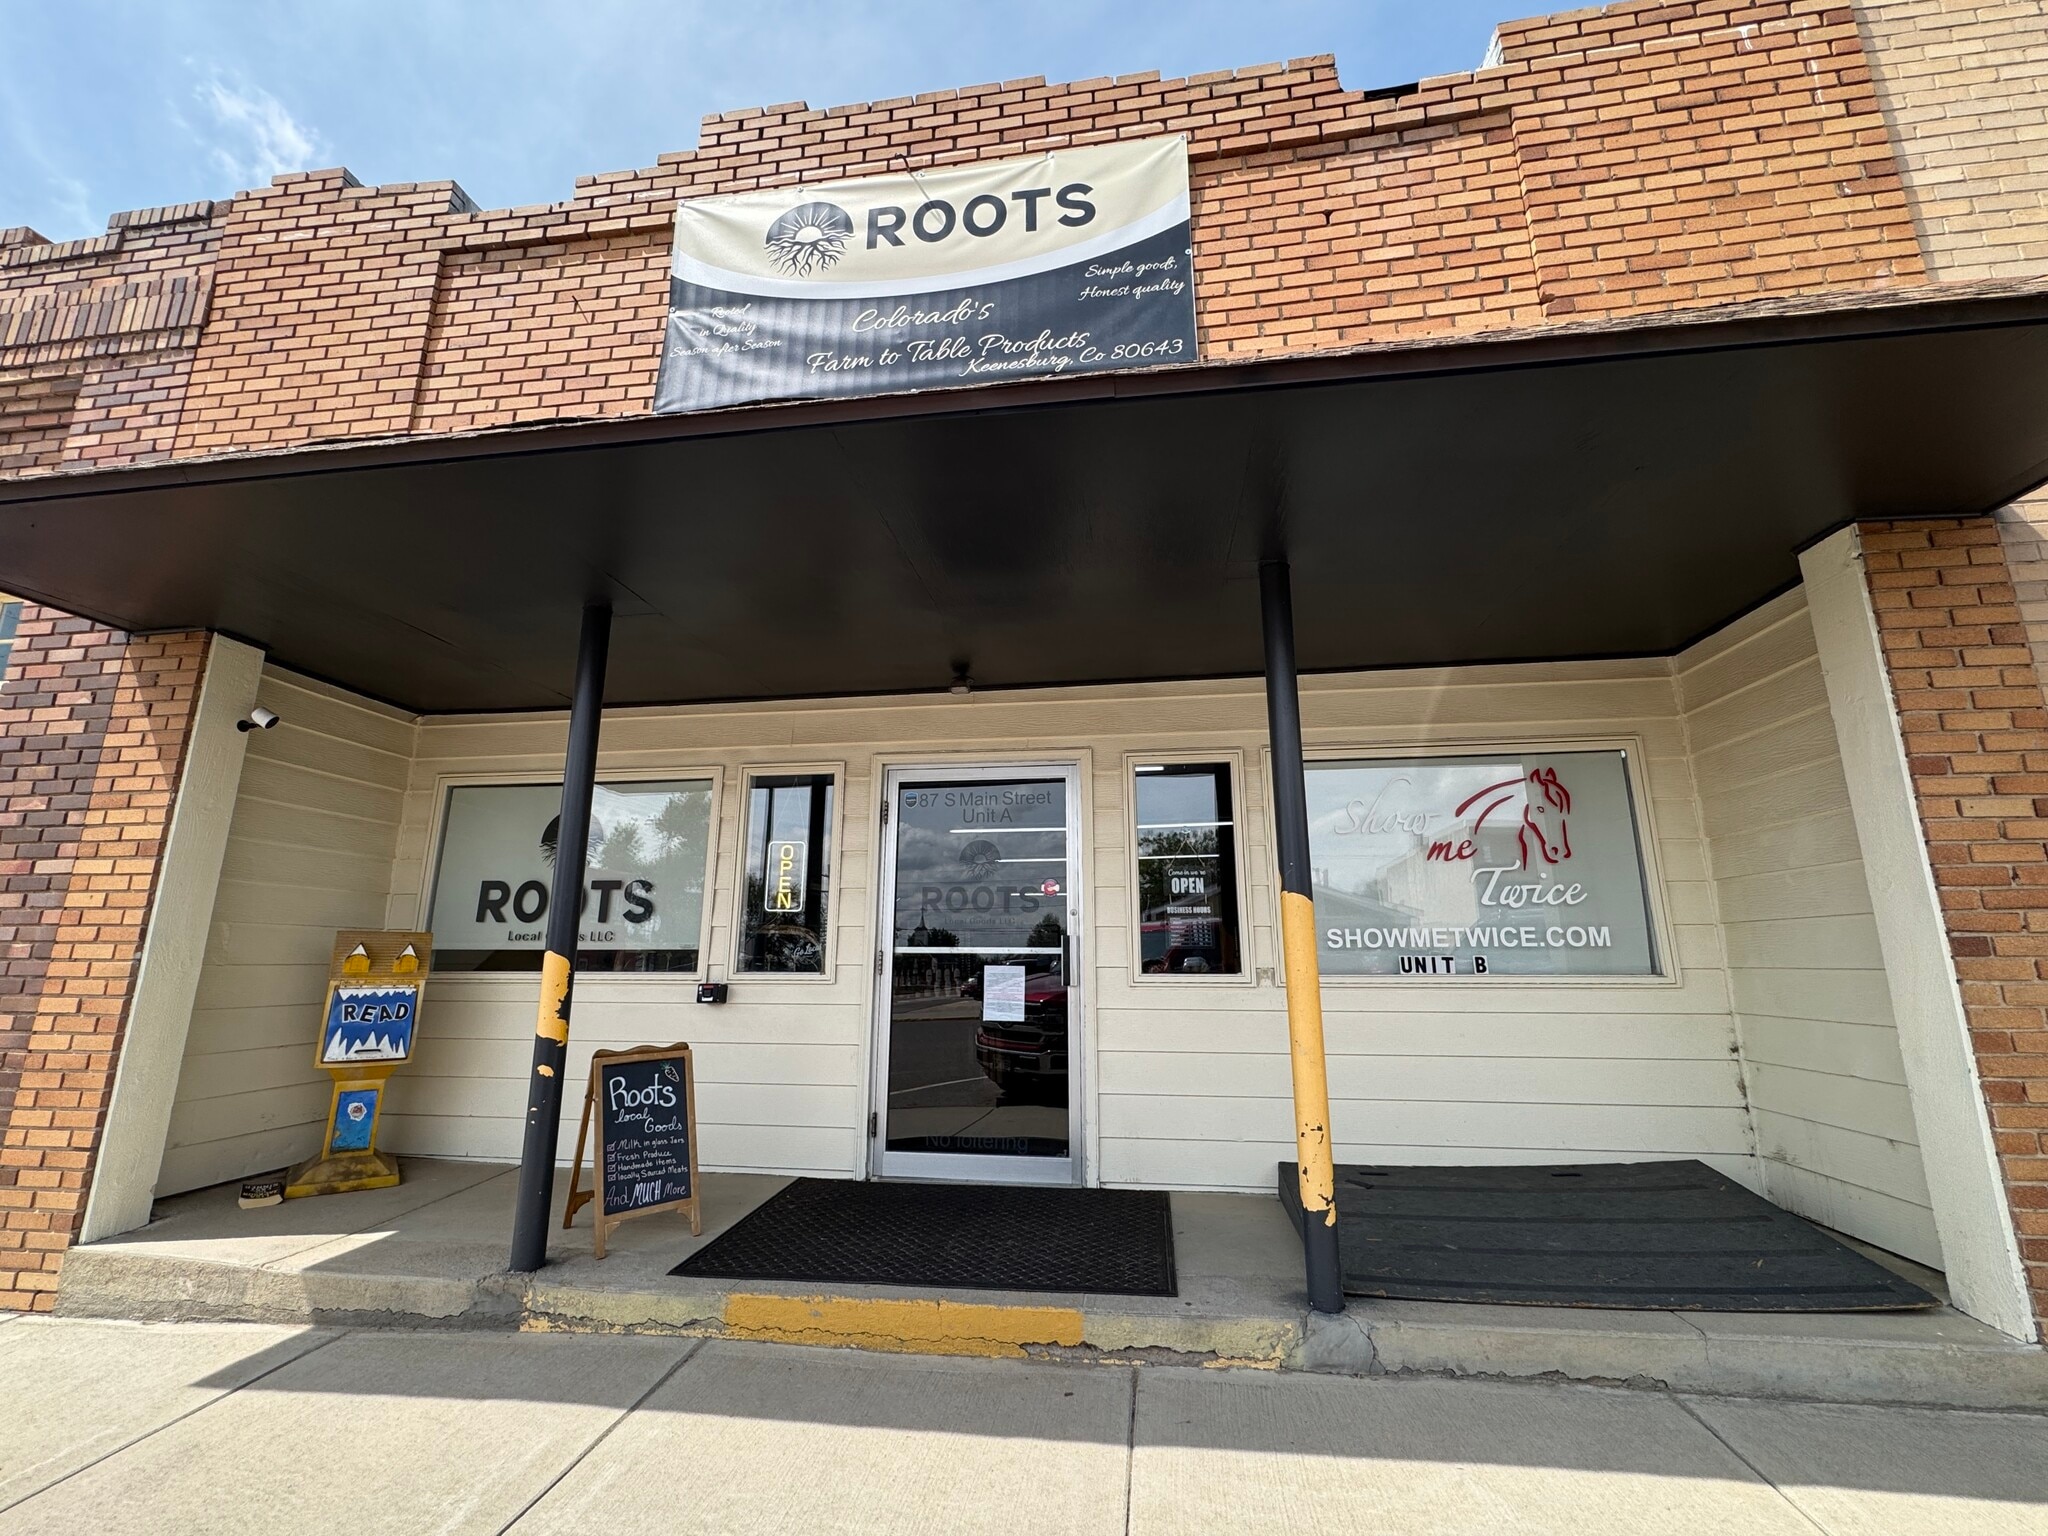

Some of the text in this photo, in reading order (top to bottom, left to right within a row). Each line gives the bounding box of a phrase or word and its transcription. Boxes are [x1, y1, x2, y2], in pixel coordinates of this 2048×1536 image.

[865, 182, 1096, 250] ROOTS
[1085, 256, 1178, 279] Simple goods,
[1078, 278, 1185, 301] Honest quality
[711, 303, 751, 318] Rooted
[852, 298, 994, 333] Colorado's
[700, 322, 757, 337] in Quality
[669, 339, 783, 358] Season after Season
[806, 329, 1091, 374] Farm to Table Products
[959, 338, 1184, 377] Keenesburg, Co 80643
[920, 790, 1052, 807] 87 S Main Street
[1334, 777, 1441, 835] Show
[963, 808, 1013, 823] Unit A
[1427, 839, 1479, 862] me
[777, 844, 794, 909] OPEN
[1171, 877, 1204, 894] OPEN
[1470, 860, 1588, 909] Twice
[475, 879, 654, 924] ROTS
[922, 885, 1040, 914] ROOTS
[1167, 906, 1211, 914] BUSINESS HOURS
[508, 930, 541, 942] Local
[590, 930, 614, 942] LLC
[1327, 926, 1611, 949] SHOWMETWICE.COM
[1400, 956, 1487, 974] UNIT B
[342, 1002, 410, 1024] READ
[609, 1073, 677, 1111] Roots
[614, 1107, 650, 1123] local
[644, 1116, 682, 1133] Goods
[617, 1139, 641, 1150] Milk
[652, 1138, 668, 1148] glass
[670, 1136, 685, 1144] Jars
[926, 1135, 950, 1148] No
[617, 1149, 672, 1161] Fresh Produce
[618, 1160, 653, 1171] Handmade
[641, 1167, 666, 1178] Sourced
[668, 1165, 688, 1174] Meats
[604, 1179, 687, 1207] And MUCH More
